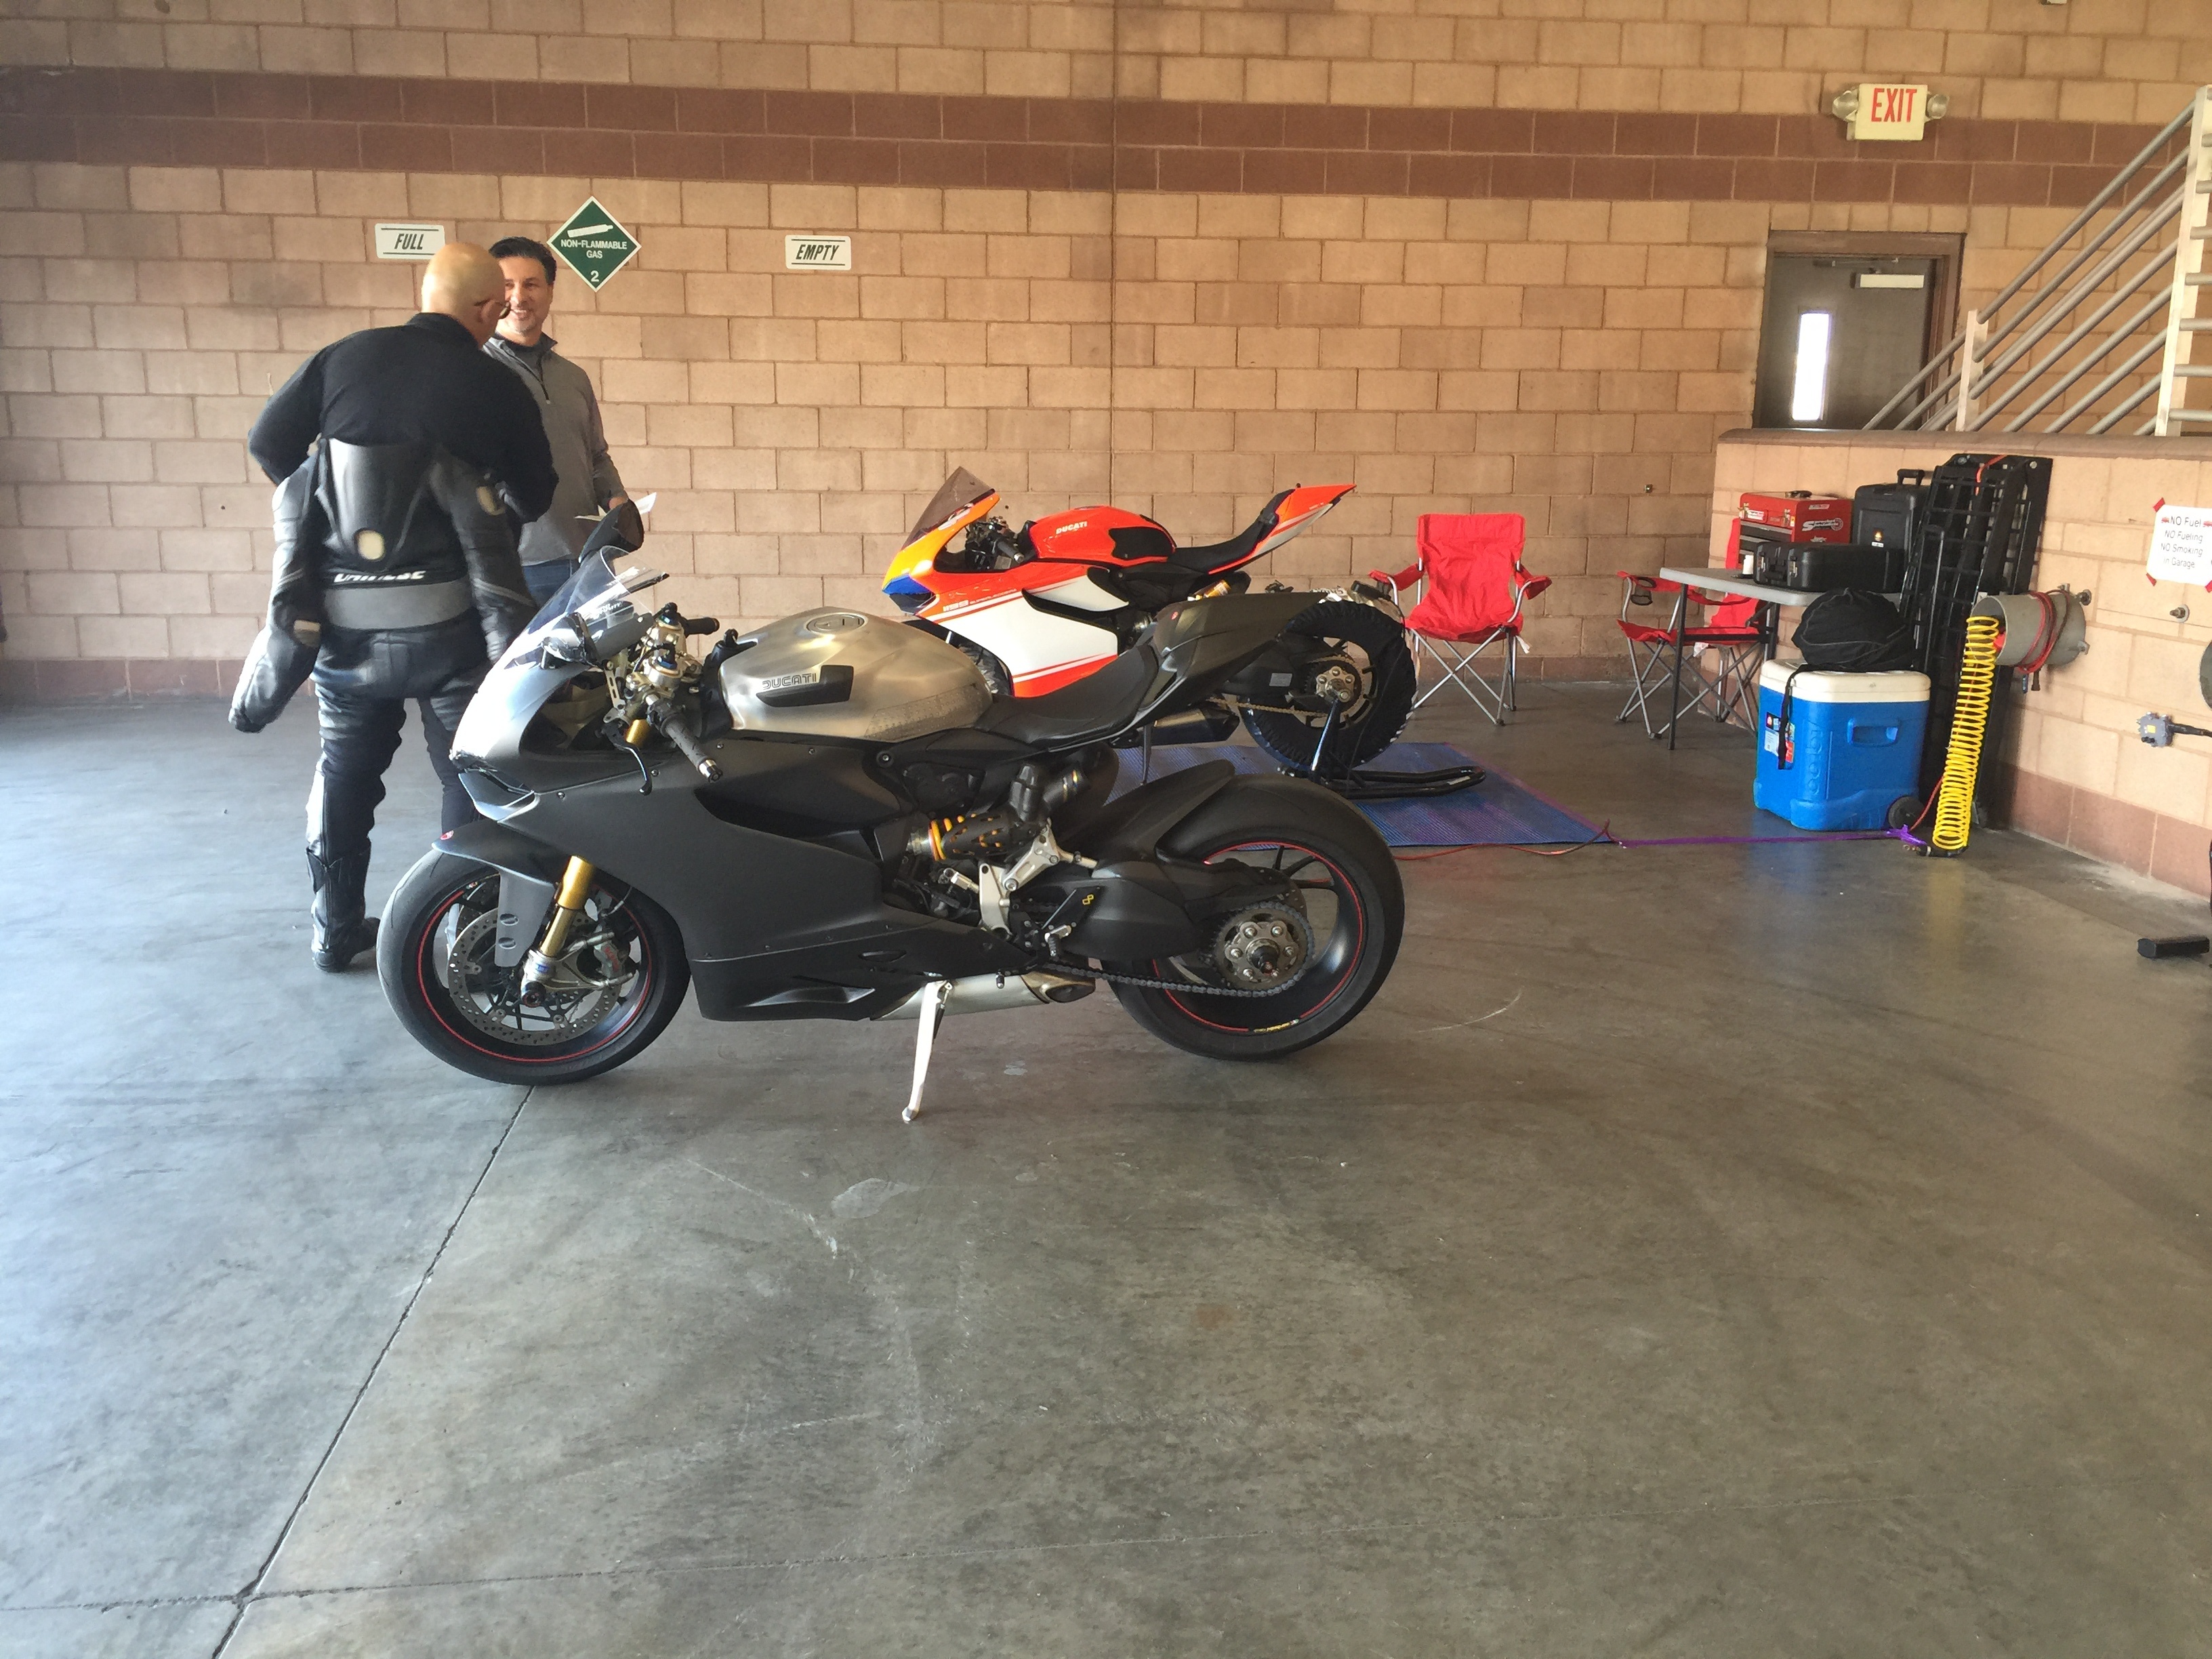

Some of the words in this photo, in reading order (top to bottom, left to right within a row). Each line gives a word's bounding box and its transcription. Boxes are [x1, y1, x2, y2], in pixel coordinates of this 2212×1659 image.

[1871, 87, 1917, 123] EXIT
[394, 233, 424, 250] FULL
[560, 239, 628, 249] NON-FLAMMABLE
[586, 250, 602, 258] GAS
[796, 244, 840, 260] EMPTY
[590, 270, 599, 282] 2
[1056, 520, 1088, 535] DUCATI
[2171, 516, 2182, 525] NO
[2184, 517, 2201, 527] Fuel
[2165, 530, 2175, 539] NO
[2177, 531, 2203, 544] Fueling
[2160, 543, 2170, 552] NO
[2172, 544, 2203, 557] Smoking
[2171, 557, 2195, 569] Garage
[762, 672, 817, 691] DUCATI
